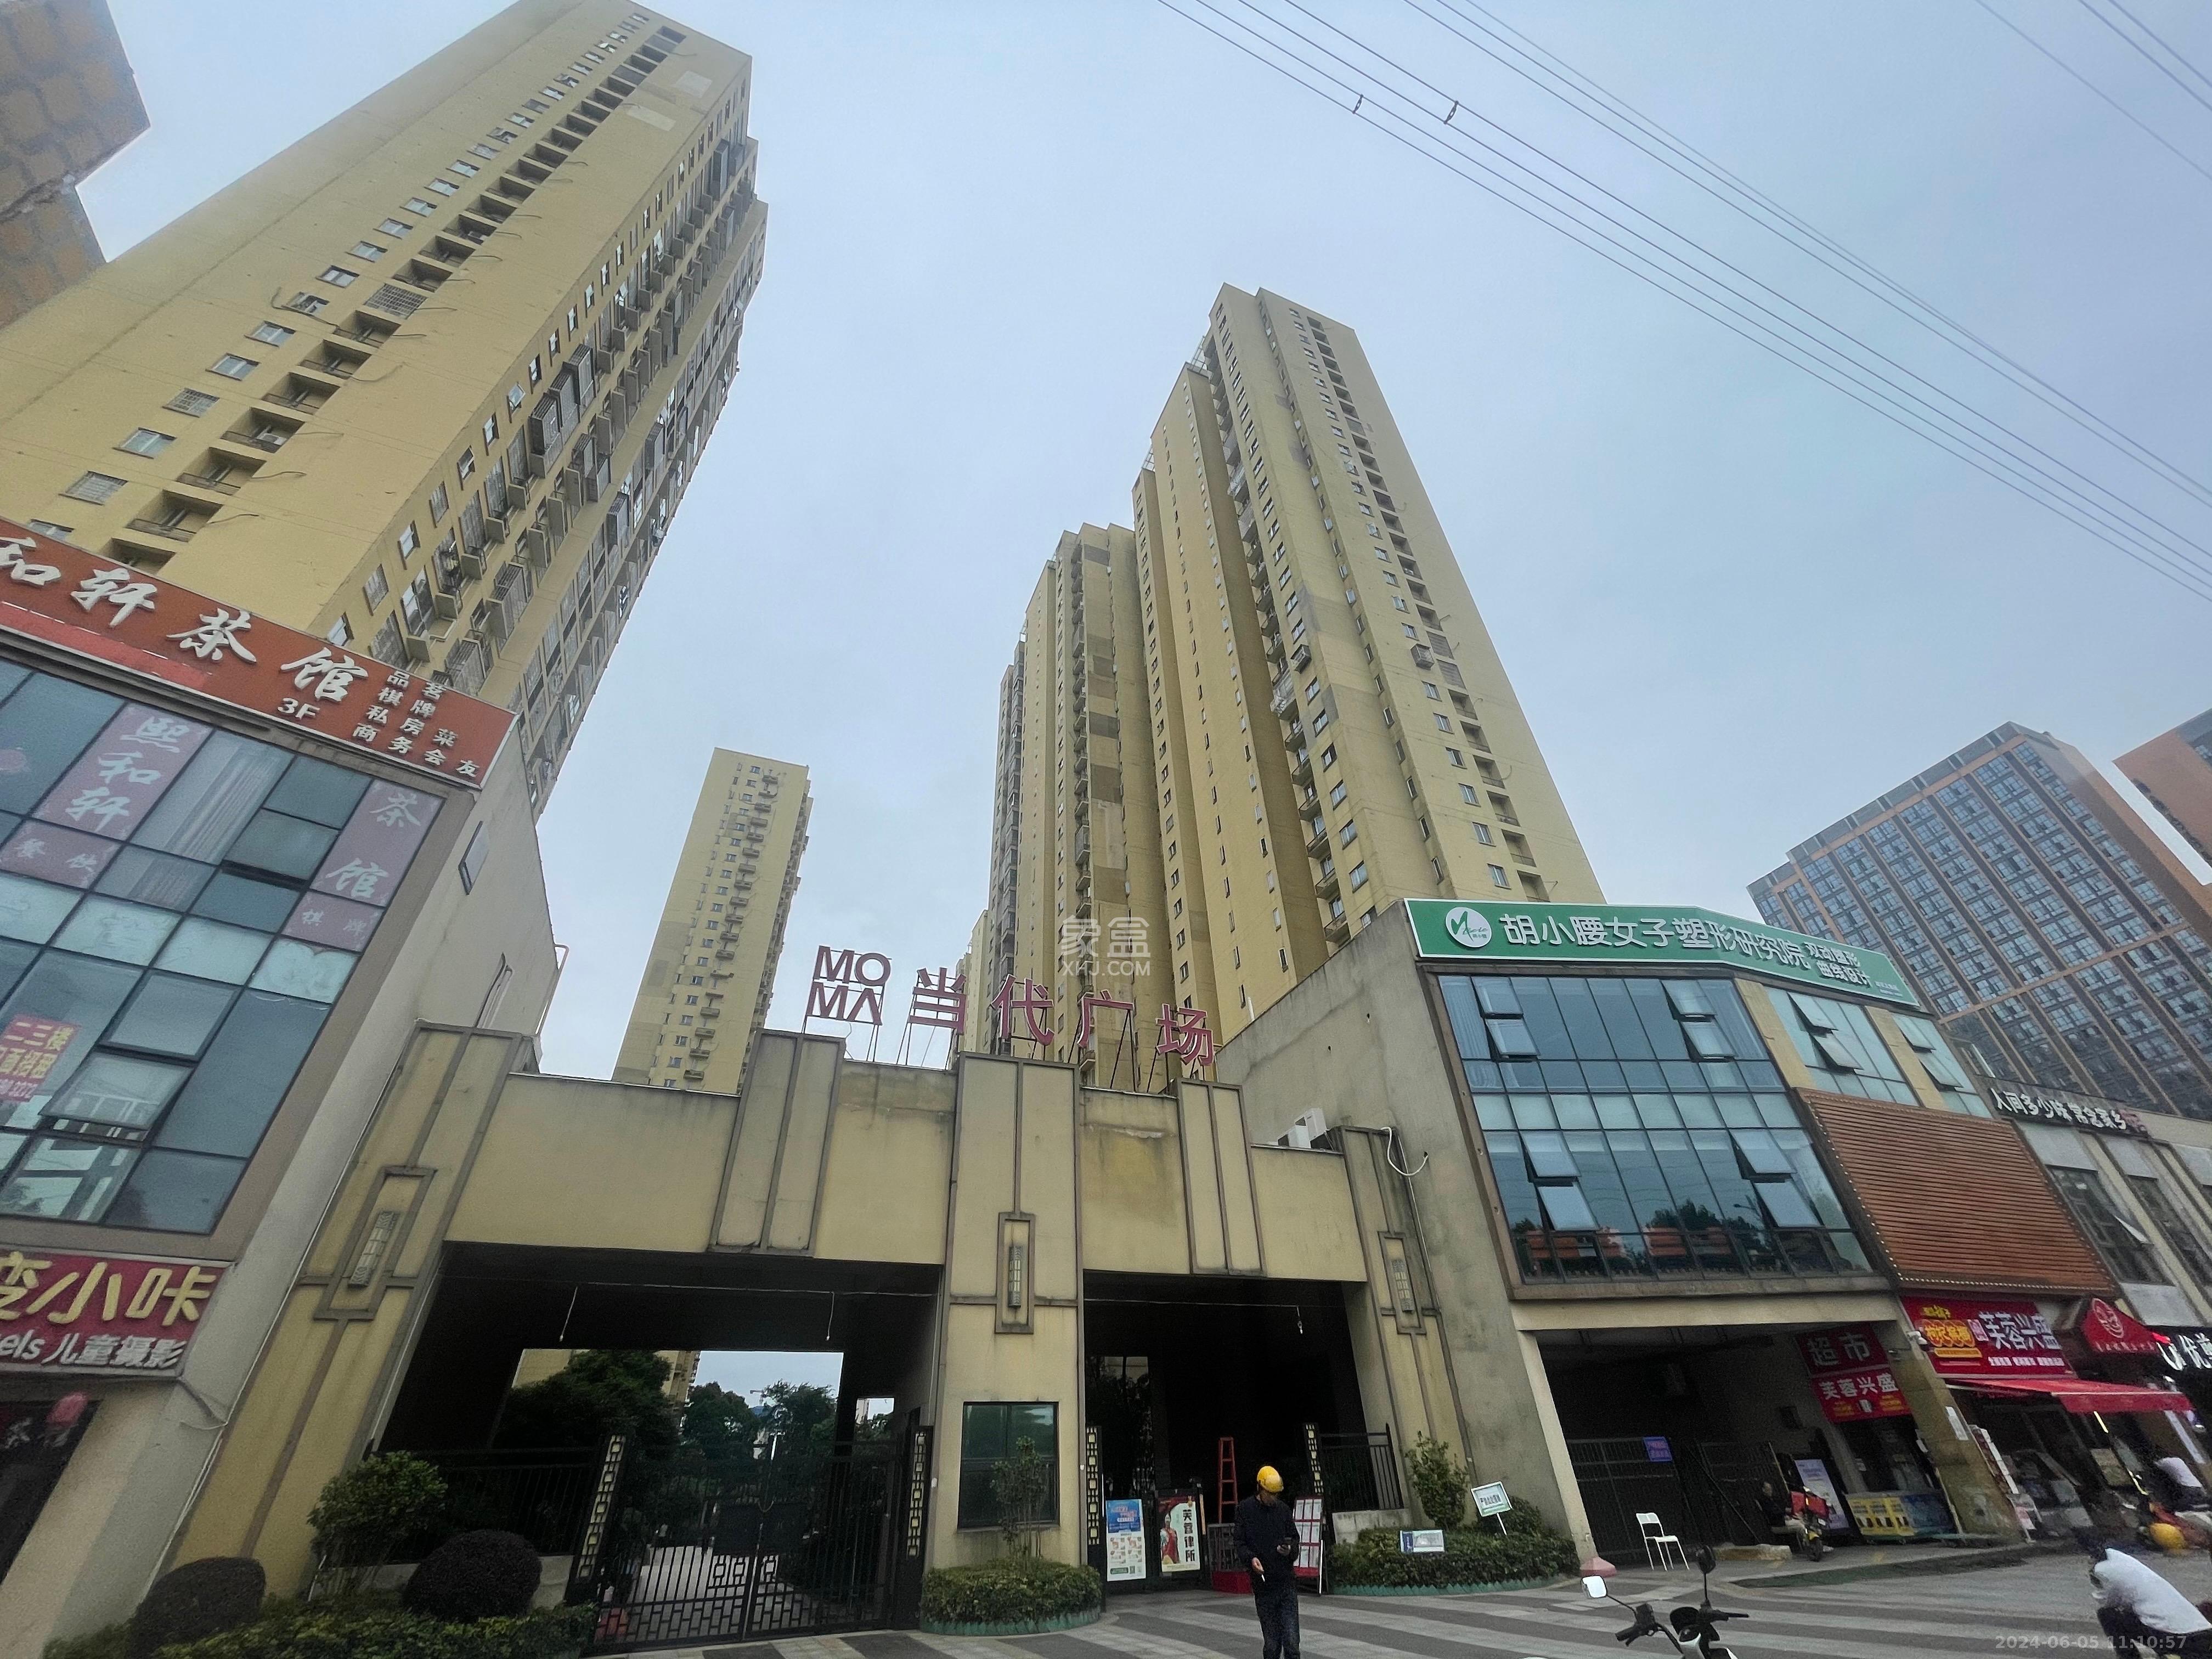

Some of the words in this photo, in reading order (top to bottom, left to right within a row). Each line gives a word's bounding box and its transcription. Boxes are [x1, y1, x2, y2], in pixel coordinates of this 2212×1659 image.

[378, 687, 436, 718] 棋牌
[387, 670, 447, 701] 品茗
[278, 697, 320, 721] 3F
[366, 704, 458, 747] 私房菜
[353, 723, 480, 777] 商务会友
[326, 792, 422, 899] 茶馆
[1499, 912, 1812, 970] 胡小腰女子塑形研究院
[814, 945, 892, 987] MO
[909, 967, 1215, 1066] 当代广场
[1807, 1333, 1870, 1365] 超市
[1978, 1311, 2062, 1350] 芙蓉兴盛
[41, 1333, 188, 1368] 儿童摄影
[1818, 1372, 1899, 1400] 芙蓉兴盛
